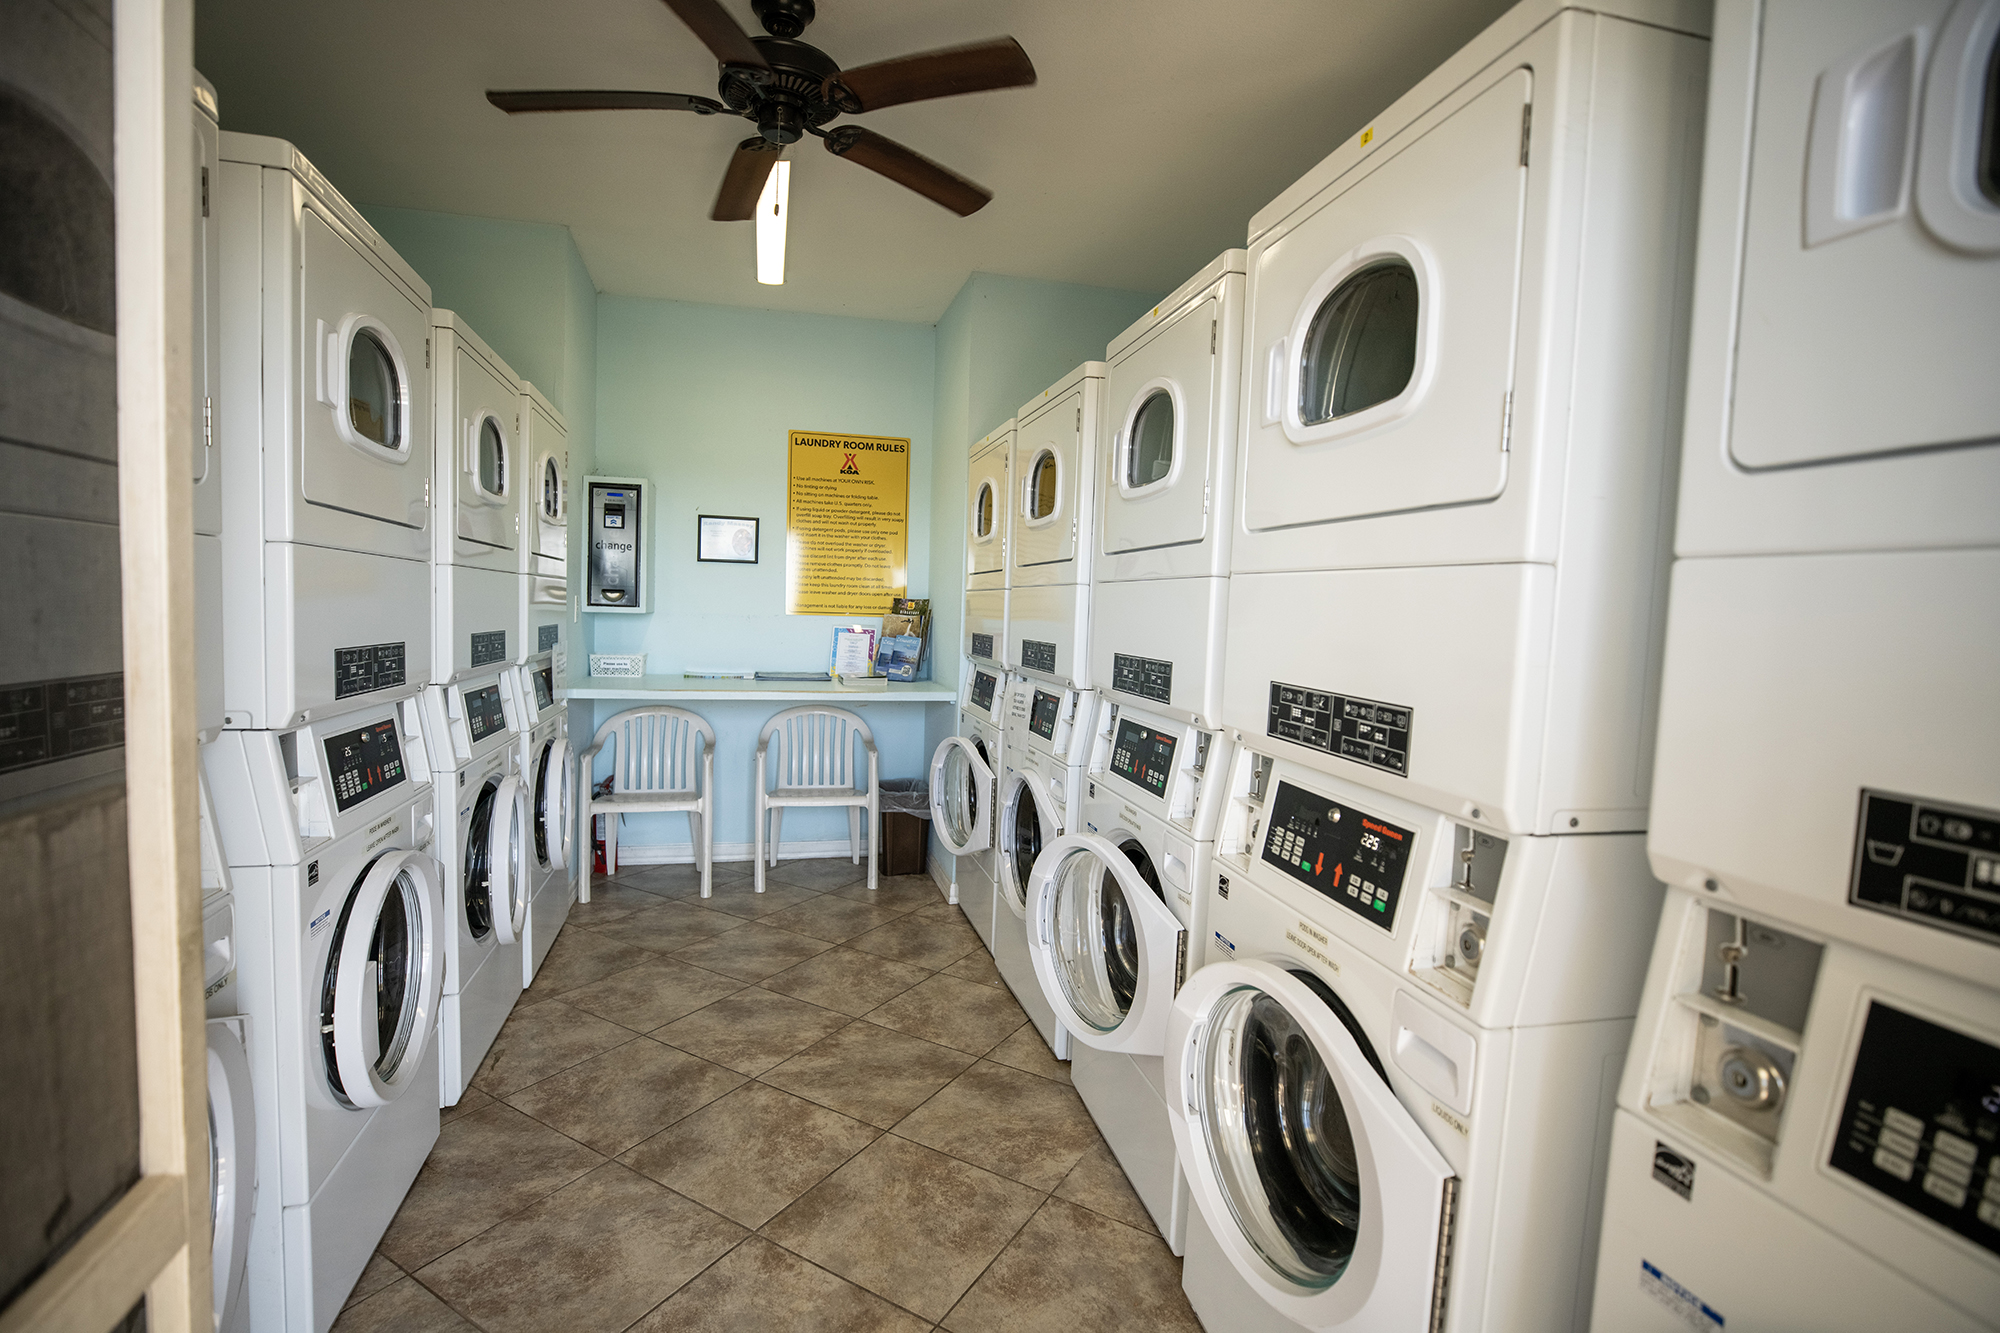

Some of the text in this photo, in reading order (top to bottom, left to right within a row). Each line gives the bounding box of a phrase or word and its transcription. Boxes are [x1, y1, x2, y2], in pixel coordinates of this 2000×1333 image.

[794, 438, 905, 453] LAUNDRY ROOM RULES
[595, 540, 632, 553] change
[1362, 818, 1382, 833] Speed
[214, 977, 228, 993] ONLY
